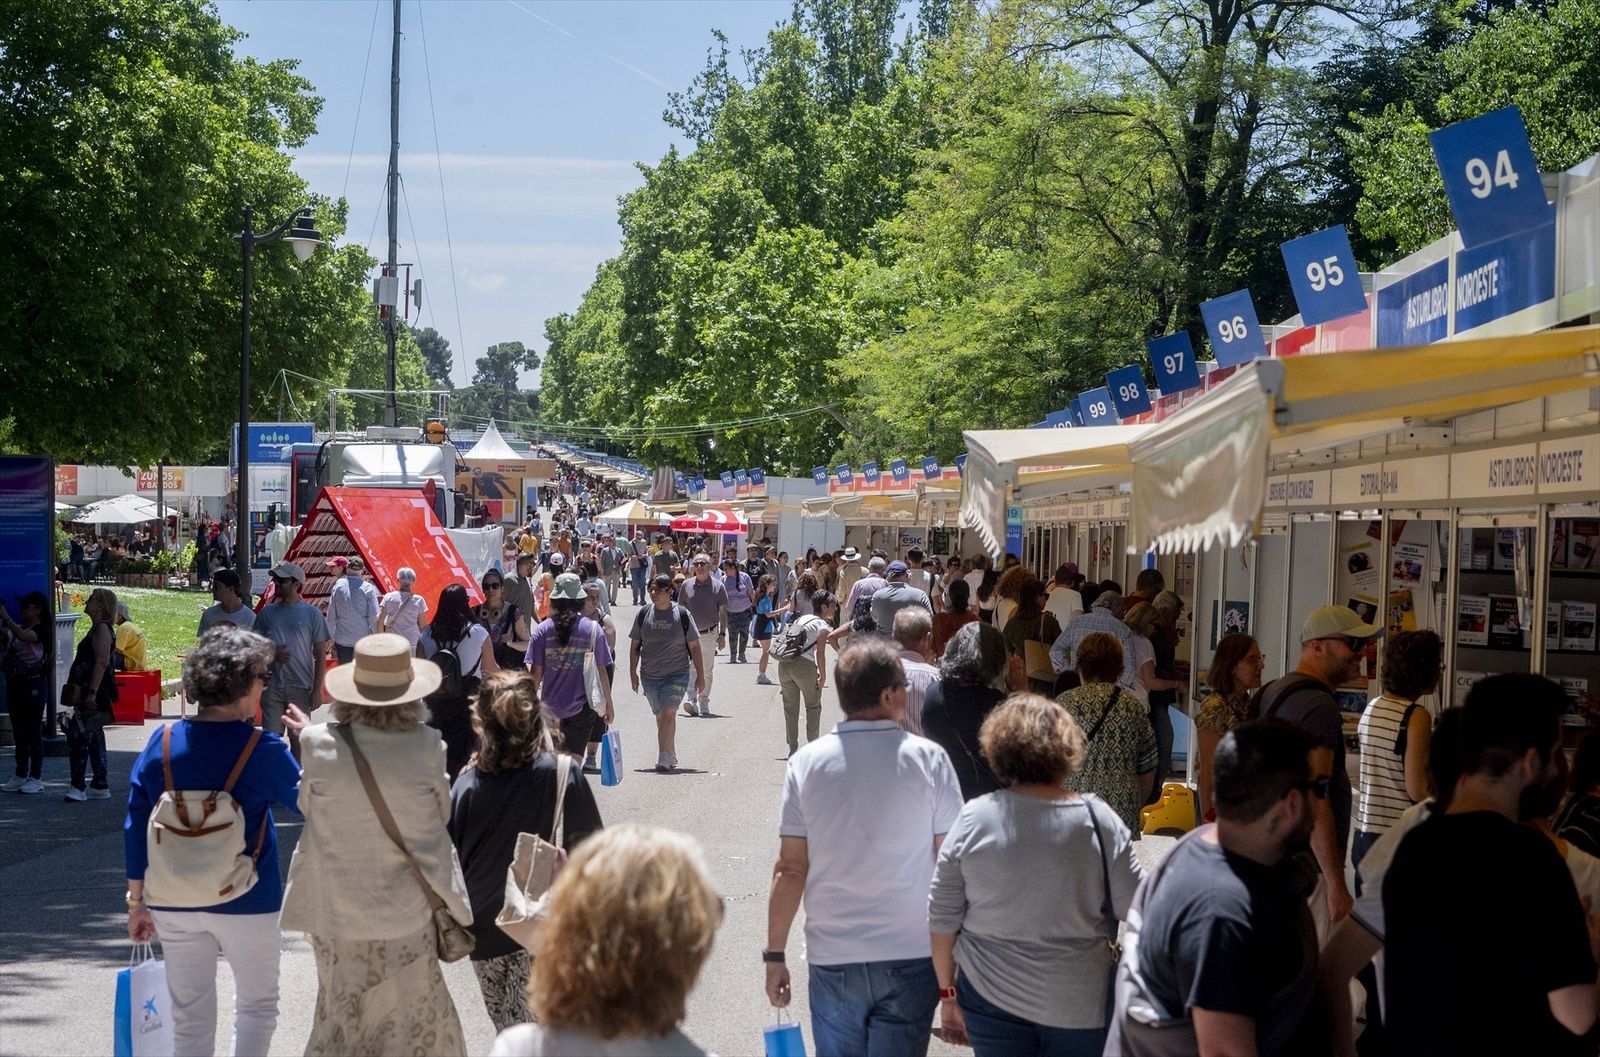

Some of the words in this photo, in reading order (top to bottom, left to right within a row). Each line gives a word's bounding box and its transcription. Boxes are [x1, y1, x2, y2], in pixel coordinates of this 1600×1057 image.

[1464, 149, 1520, 200] 94
[1305, 254, 1344, 292] 95
[1456, 258, 1499, 313] NOROESTE
[1218, 315, 1248, 343] 96
[1163, 351, 1184, 375] 97
[1118, 382, 1140, 402] 98
[1089, 401, 1107, 418] 99
[815, 472, 826, 480] 110
[866, 468, 878, 478] 108
[893, 466, 905, 476] 107
[925, 463, 938, 474] 106
[1488, 455, 1536, 488] ASTURLIBROS
[1540, 449, 1583, 485] NOROESTE
[140, 481, 146, 489] Y
[147, 481, 178, 489] BADOS
[902, 535, 922, 545] esic
